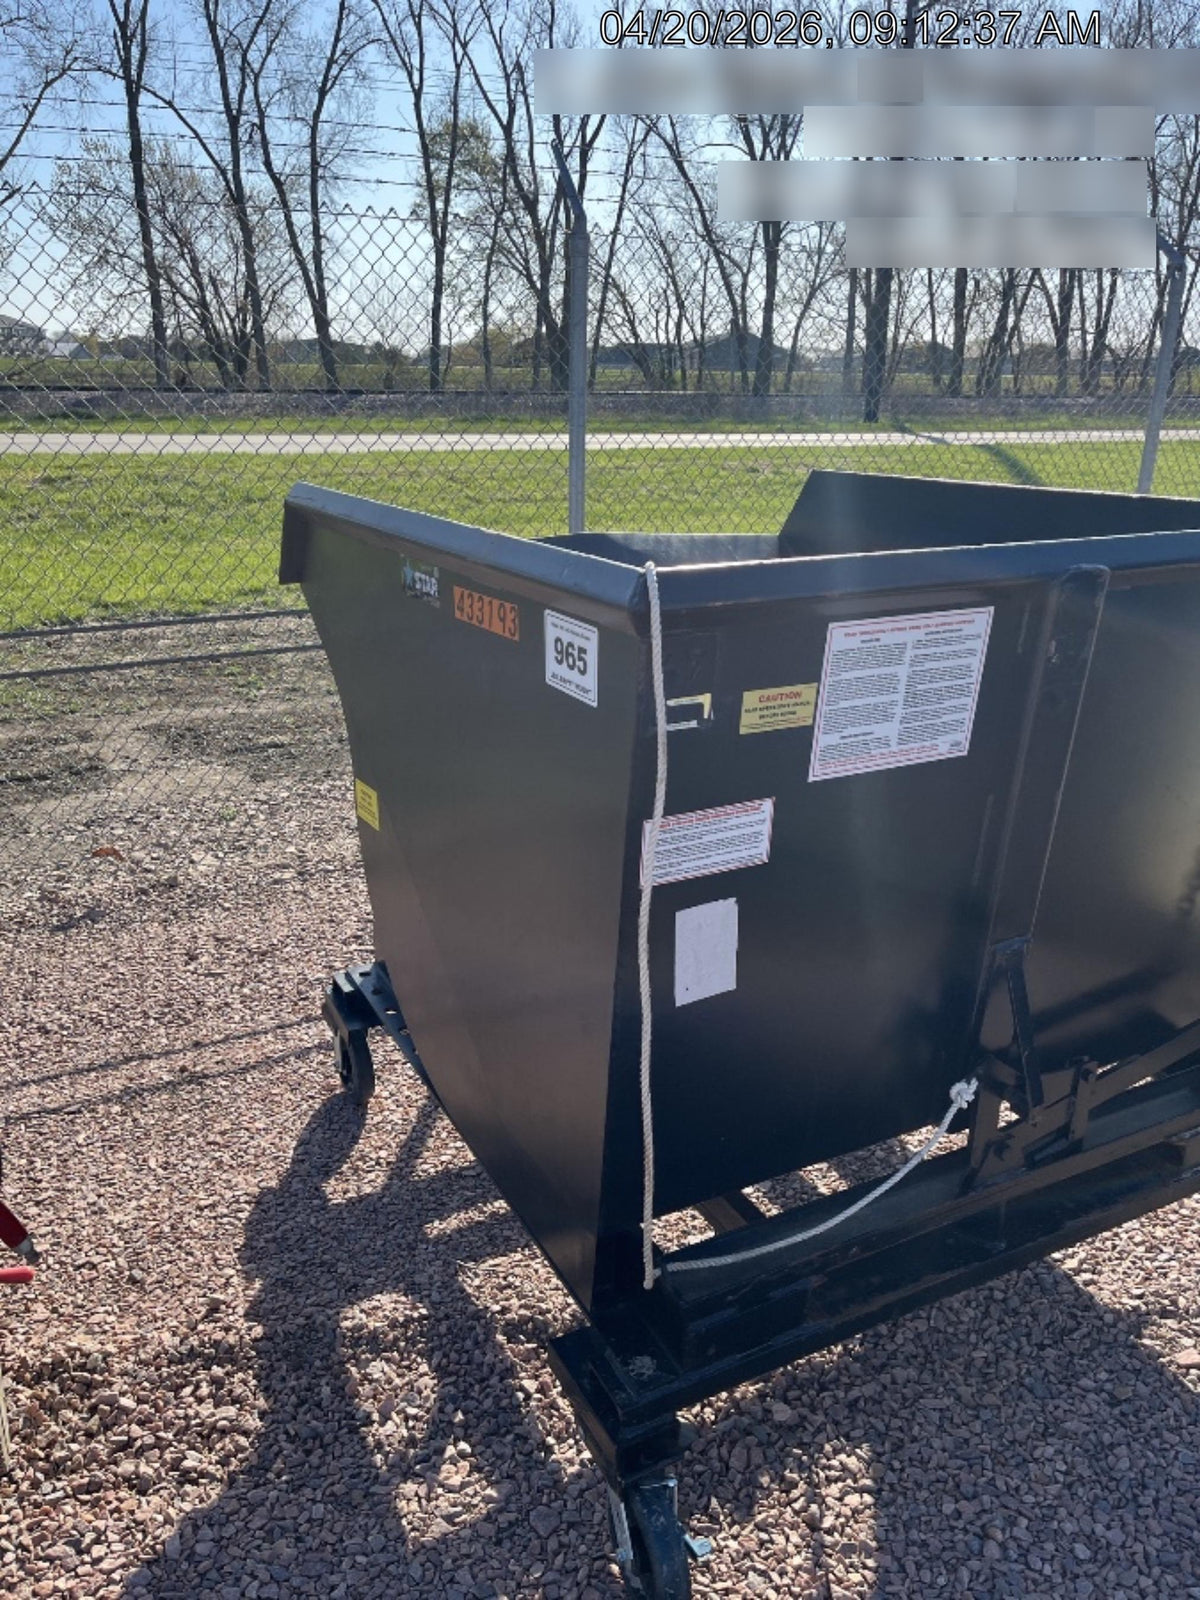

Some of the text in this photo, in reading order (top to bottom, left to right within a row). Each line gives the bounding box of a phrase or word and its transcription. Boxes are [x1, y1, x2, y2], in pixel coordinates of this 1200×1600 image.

[456, 590, 519, 638] 433193
[554, 637, 588, 676] 965
[758, 690, 803, 704] CAUTION
